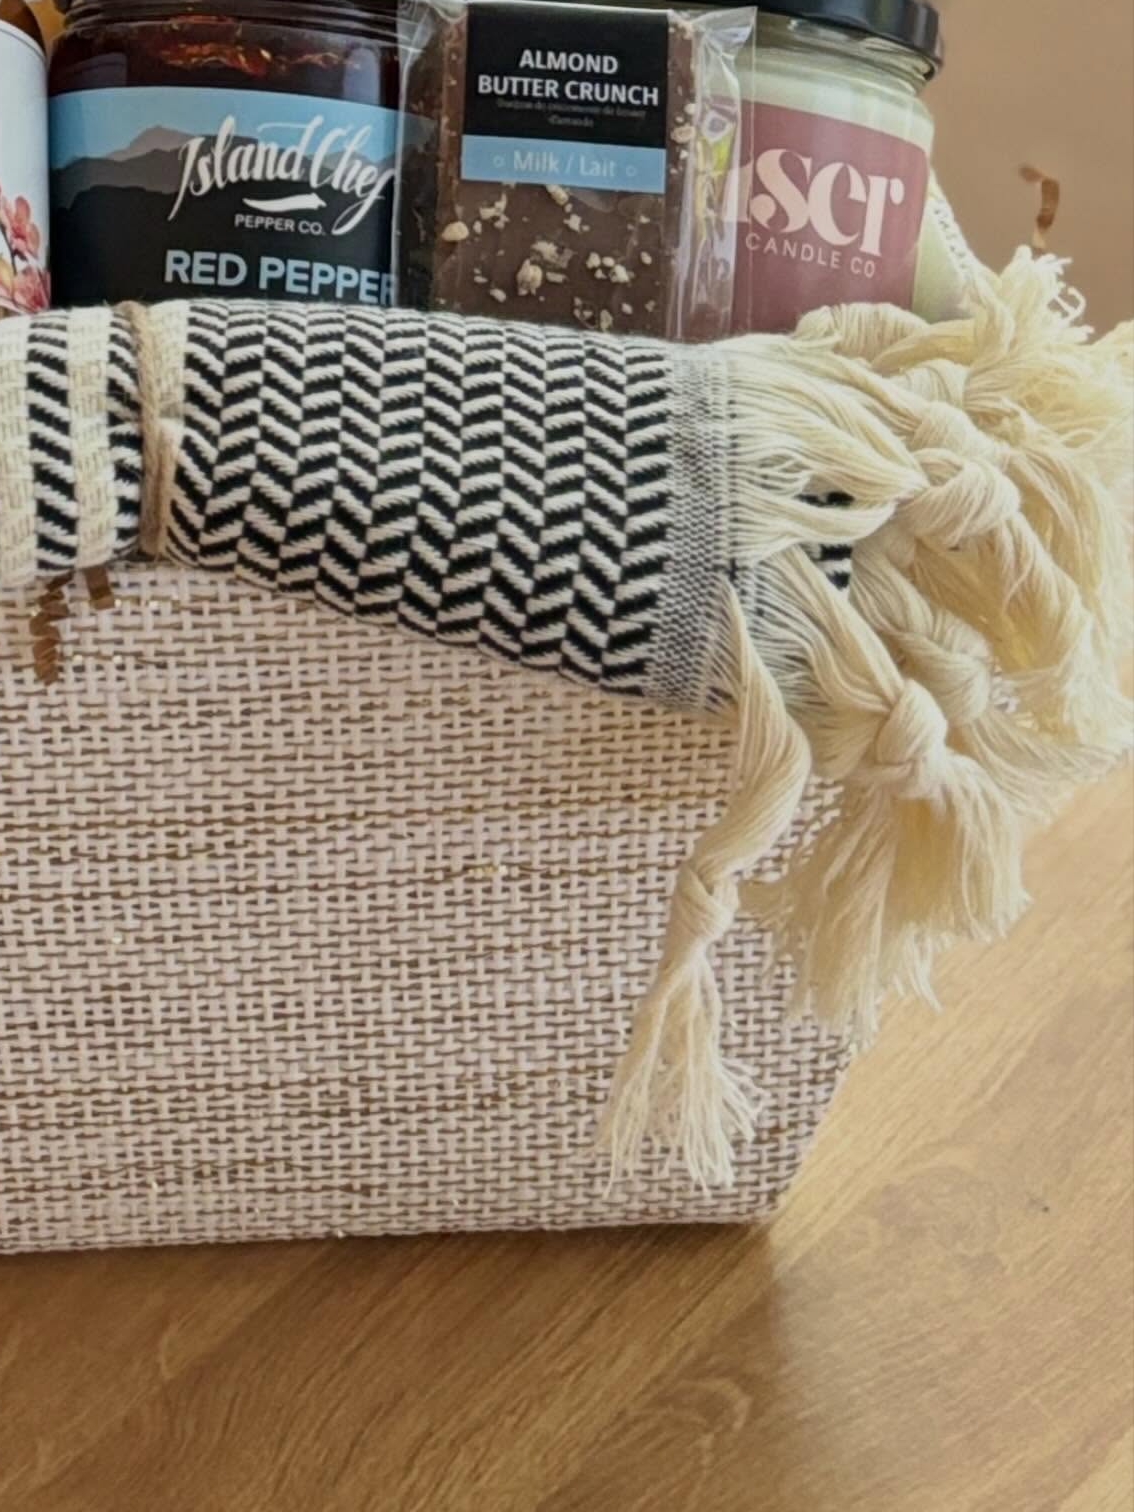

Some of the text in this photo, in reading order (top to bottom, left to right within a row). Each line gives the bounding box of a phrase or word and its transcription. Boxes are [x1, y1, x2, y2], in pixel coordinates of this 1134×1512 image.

[518, 48, 619, 75] ALMOND
[477, 73, 659, 107] BUTTER CRUNCH
[168, 114, 398, 238] Island Chef
[513, 149, 560, 173] Milk
[579, 154, 617, 178] Lait
[234, 212, 295, 234] PEPPER
[164, 248, 248, 286] RED
[744, 231, 877, 280] CANDLE CO
